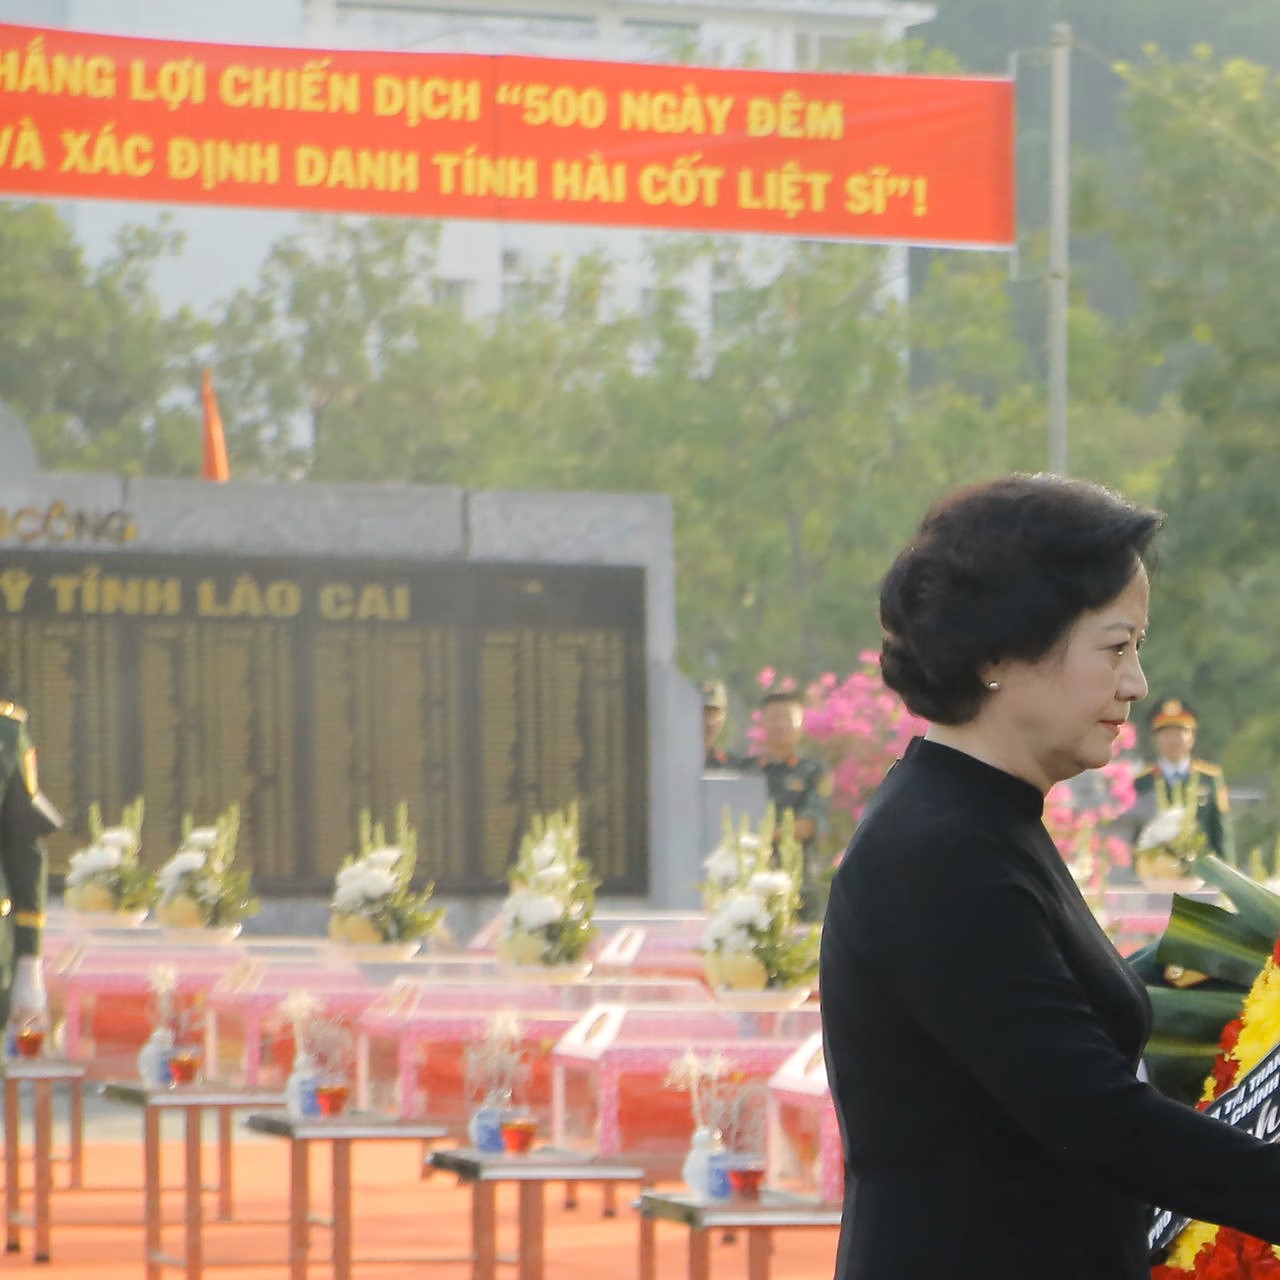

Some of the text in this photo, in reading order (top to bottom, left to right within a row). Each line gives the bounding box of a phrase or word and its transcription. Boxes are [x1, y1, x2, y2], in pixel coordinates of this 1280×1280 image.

[0, 35, 116, 98] HẮNG
[130, 56, 205, 110] LỢI
[218, 57, 361, 115] CHIẾN
[373, 75, 481, 128] DỊCH
[619, 83, 735, 136] NGÀY
[746, 91, 844, 140] ĐÊM
[60, 122, 154, 178] XÁC
[167, 137, 281, 191] ĐỊNH
[296, 145, 419, 193] DANH
[432, 143, 537, 198] TÍNH
[552, 149, 627, 204] HÀI
[639, 151, 725, 208] CỐT
[738, 159, 832, 219] LIỆT
[0, 566, 34, 613] Ỹ
[197, 572, 301, 619] LÀO
[319, 582, 411, 621] CAI
[1230, 1072, 1280, 1125] CHÍNH
